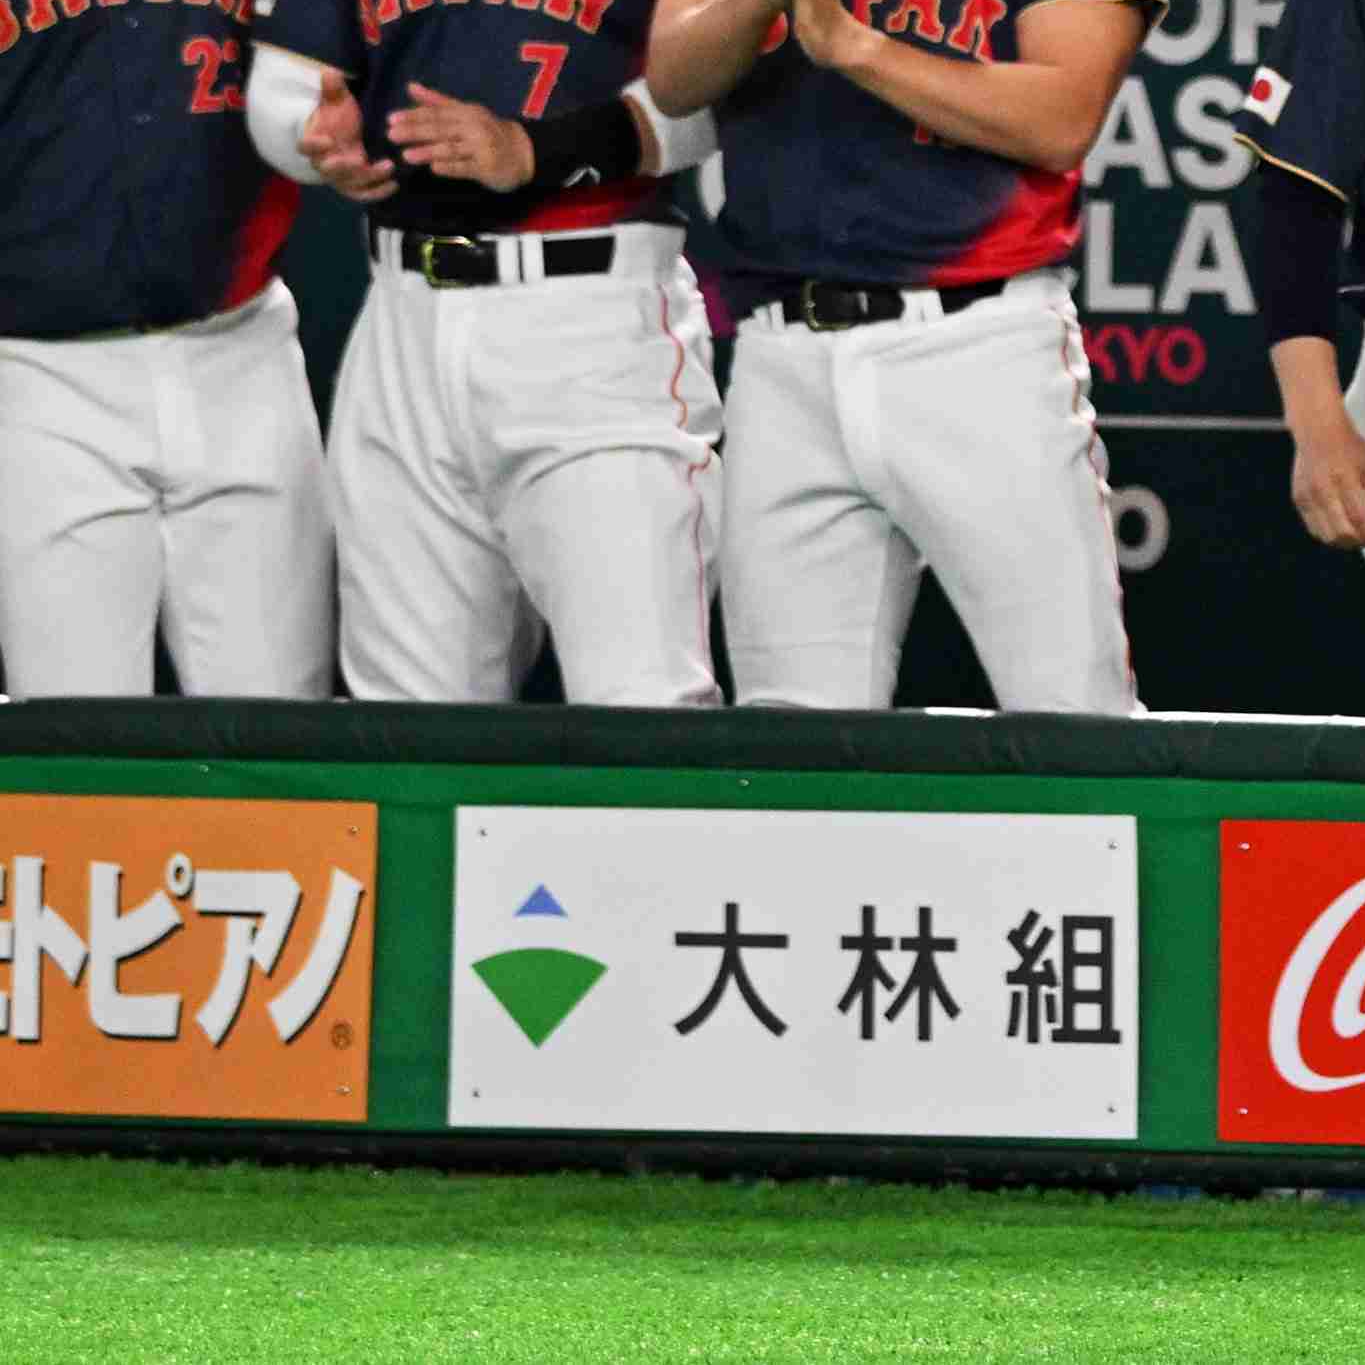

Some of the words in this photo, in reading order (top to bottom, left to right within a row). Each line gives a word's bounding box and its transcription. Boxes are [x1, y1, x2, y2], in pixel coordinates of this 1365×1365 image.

[520, 40, 569, 120] 7
[0, 851, 366, 1049] トピアノ
[673, 900, 1124, 1046] 大林組
